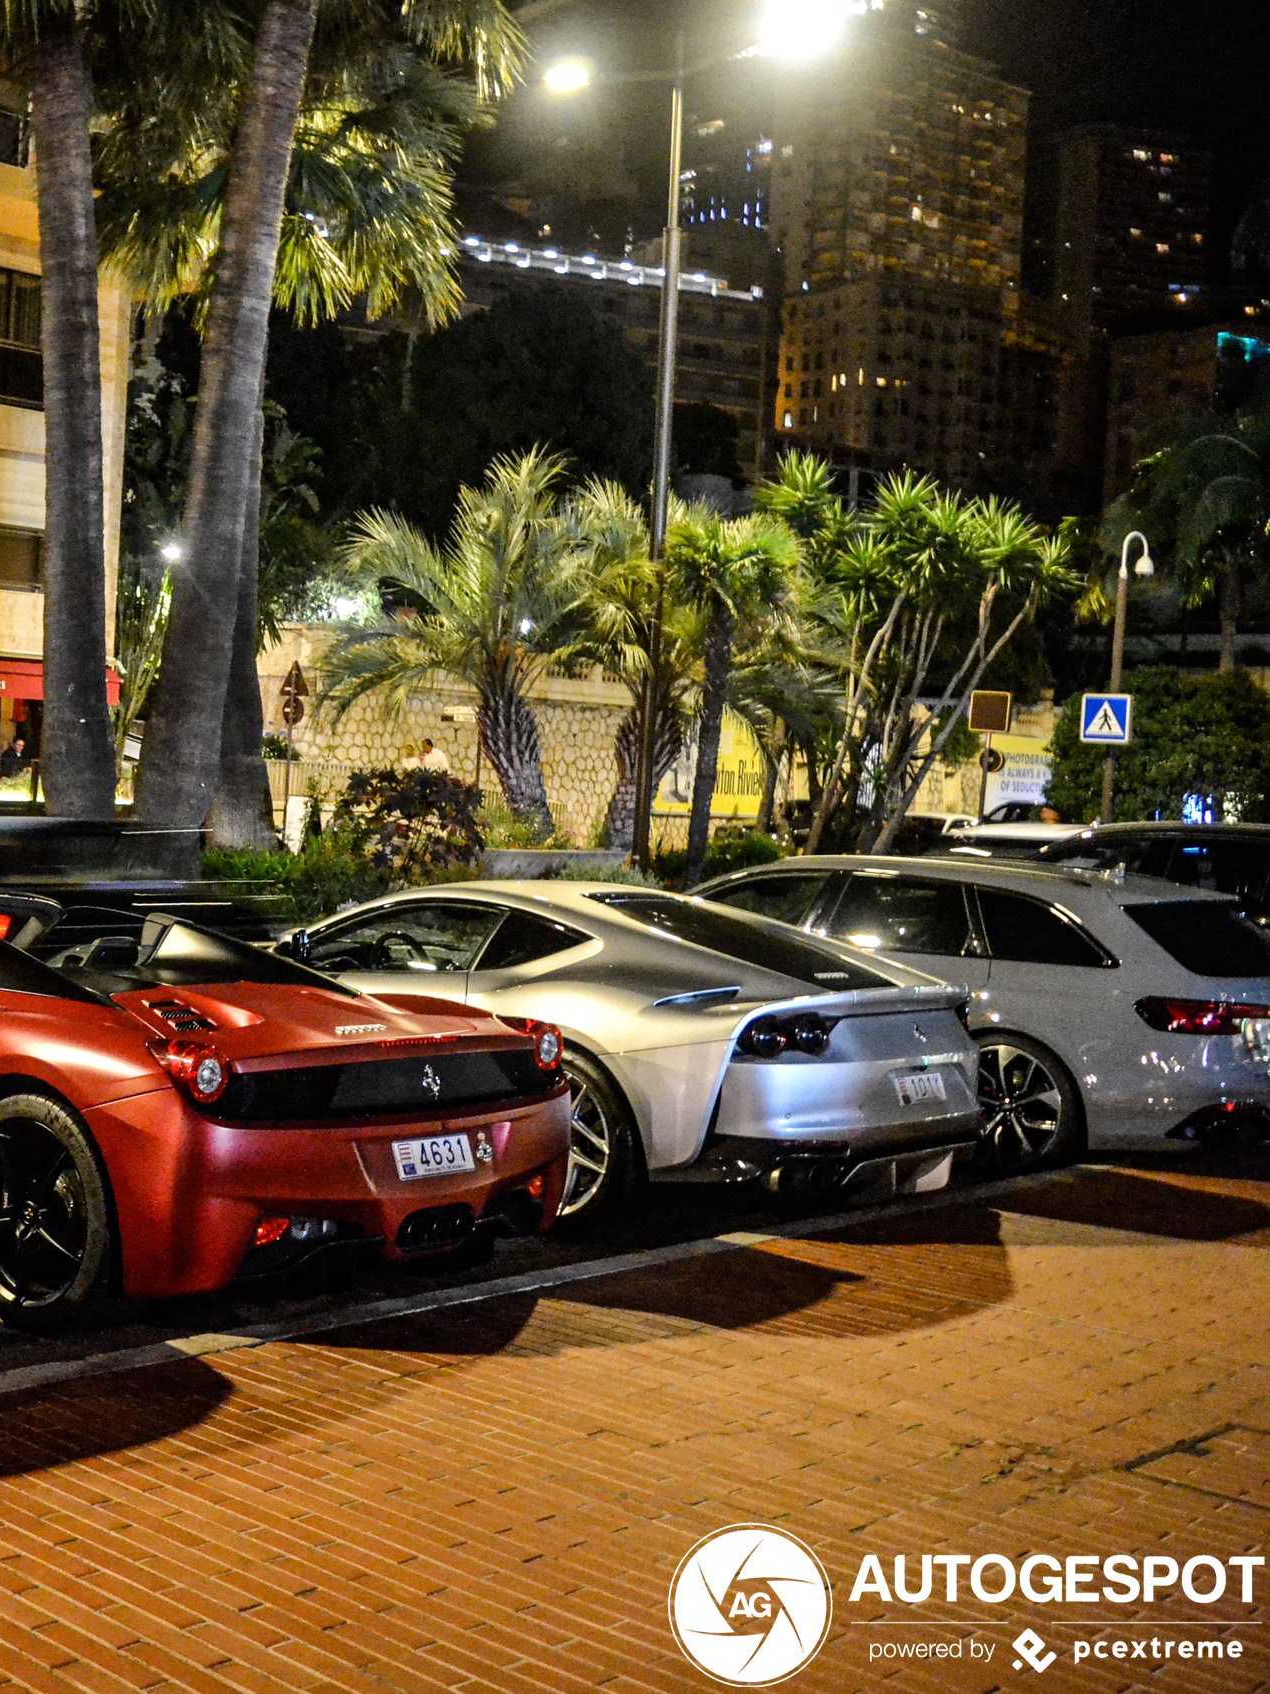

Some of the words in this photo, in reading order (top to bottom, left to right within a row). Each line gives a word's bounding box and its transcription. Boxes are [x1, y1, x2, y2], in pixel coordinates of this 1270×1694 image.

[1007, 767, 1034, 778] ALWAYS
[1000, 781, 1010, 791] OF
[420, 1138, 467, 1167] 4631
